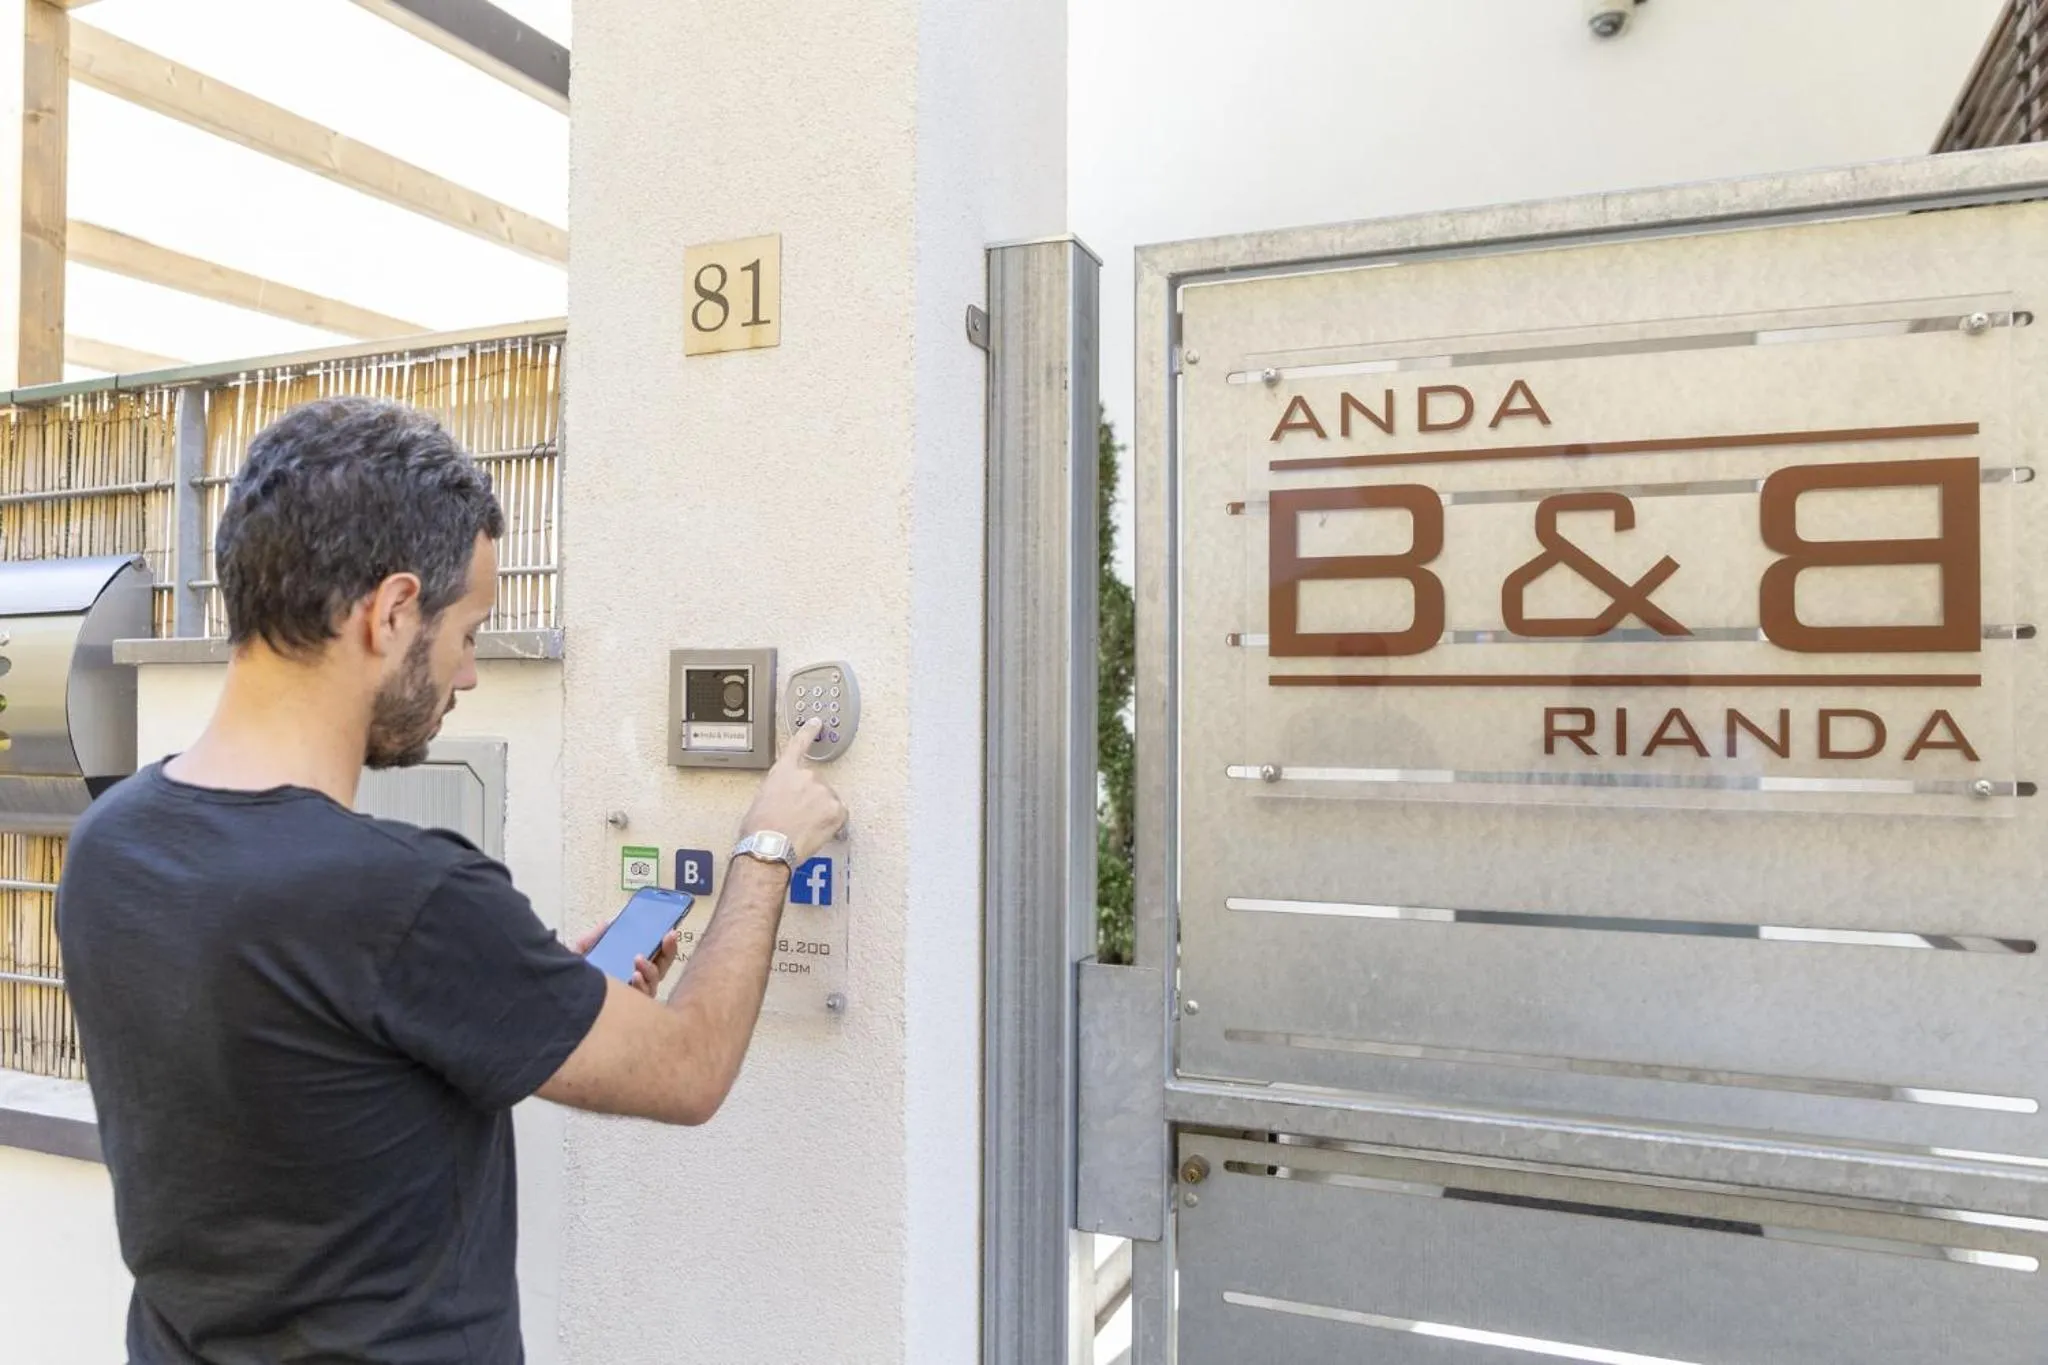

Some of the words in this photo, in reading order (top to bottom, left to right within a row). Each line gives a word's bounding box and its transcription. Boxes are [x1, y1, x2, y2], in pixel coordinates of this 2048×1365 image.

[691, 258, 771, 332] 81
[1270, 379, 1553, 442] ANDA
[1544, 706, 1980, 762] RIANDA
[806, 863, 827, 905] f
[774, 961, 811, 975] .COM
[776, 939, 830, 955] 8.200
